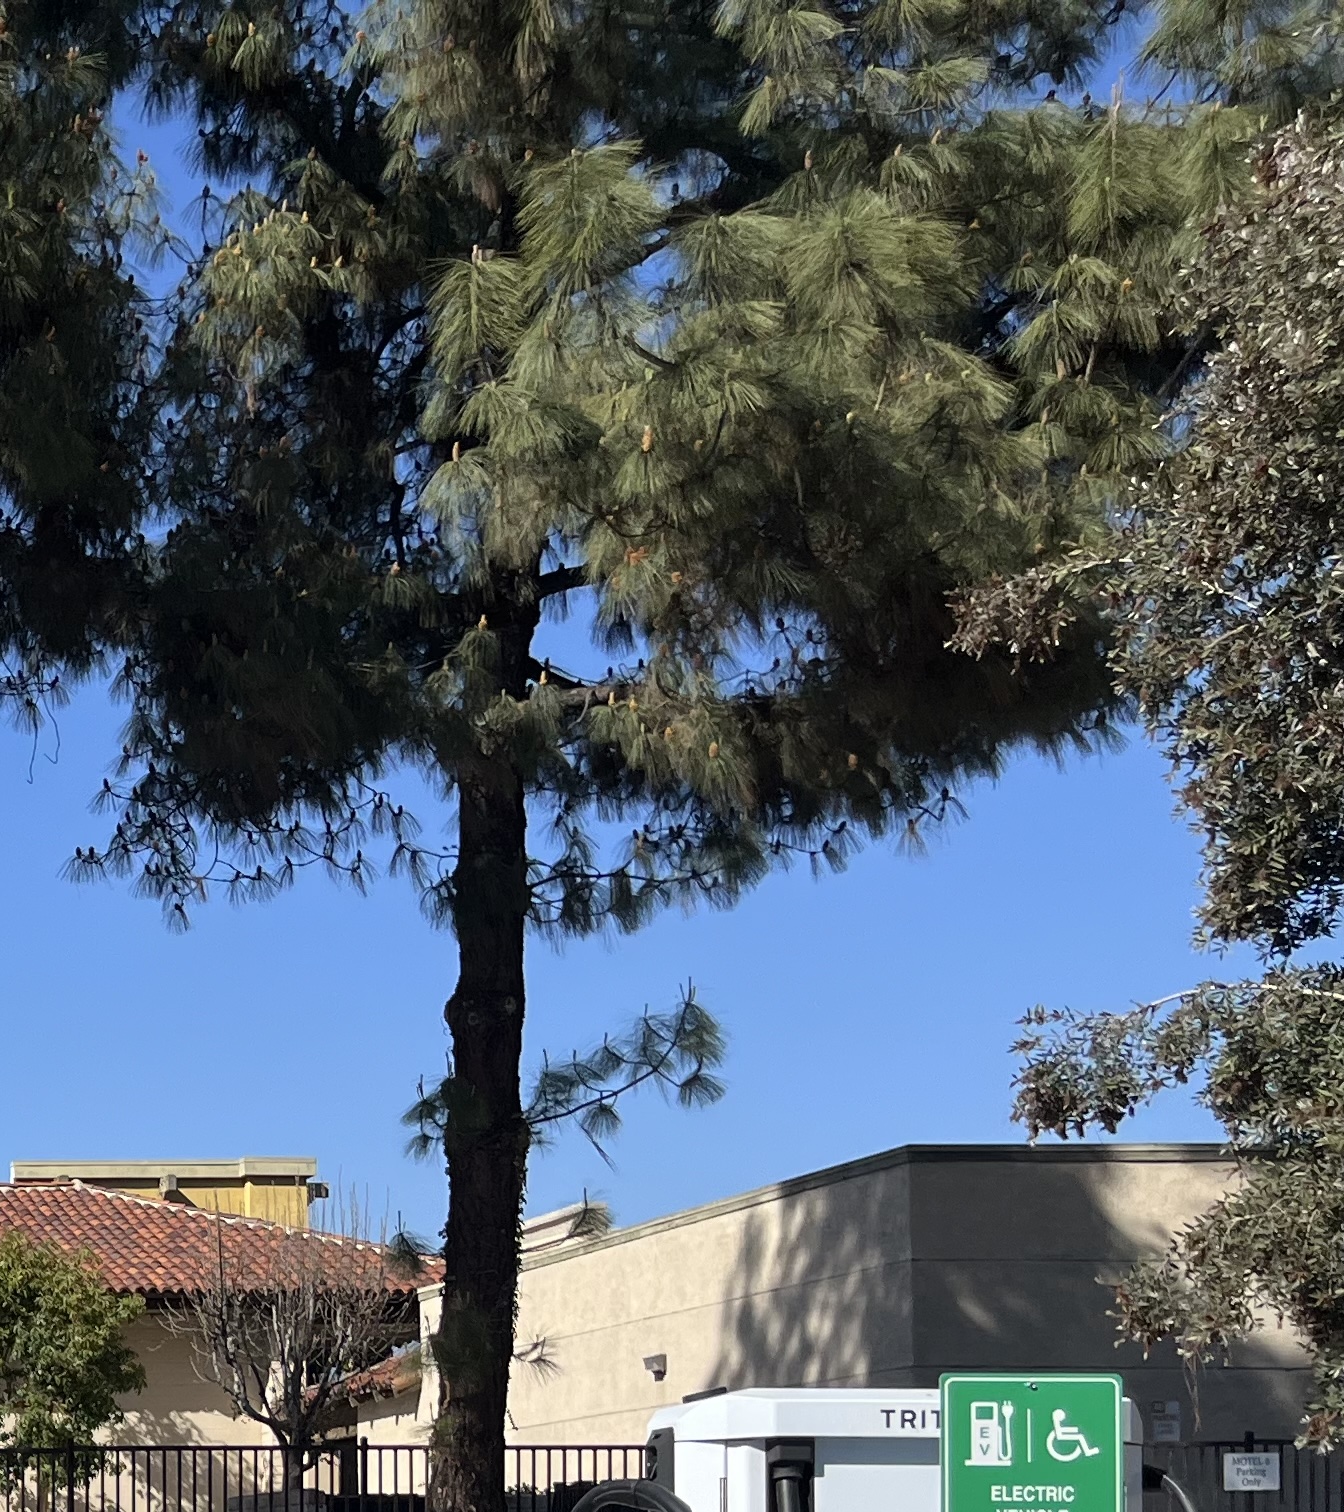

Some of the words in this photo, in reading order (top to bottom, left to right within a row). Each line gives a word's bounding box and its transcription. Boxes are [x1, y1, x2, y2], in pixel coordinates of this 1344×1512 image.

[1236, 1467, 1267, 1478] Parking
[1241, 1478, 1262, 1487] Only
[990, 1485, 1075, 1502] ELECTRIC
